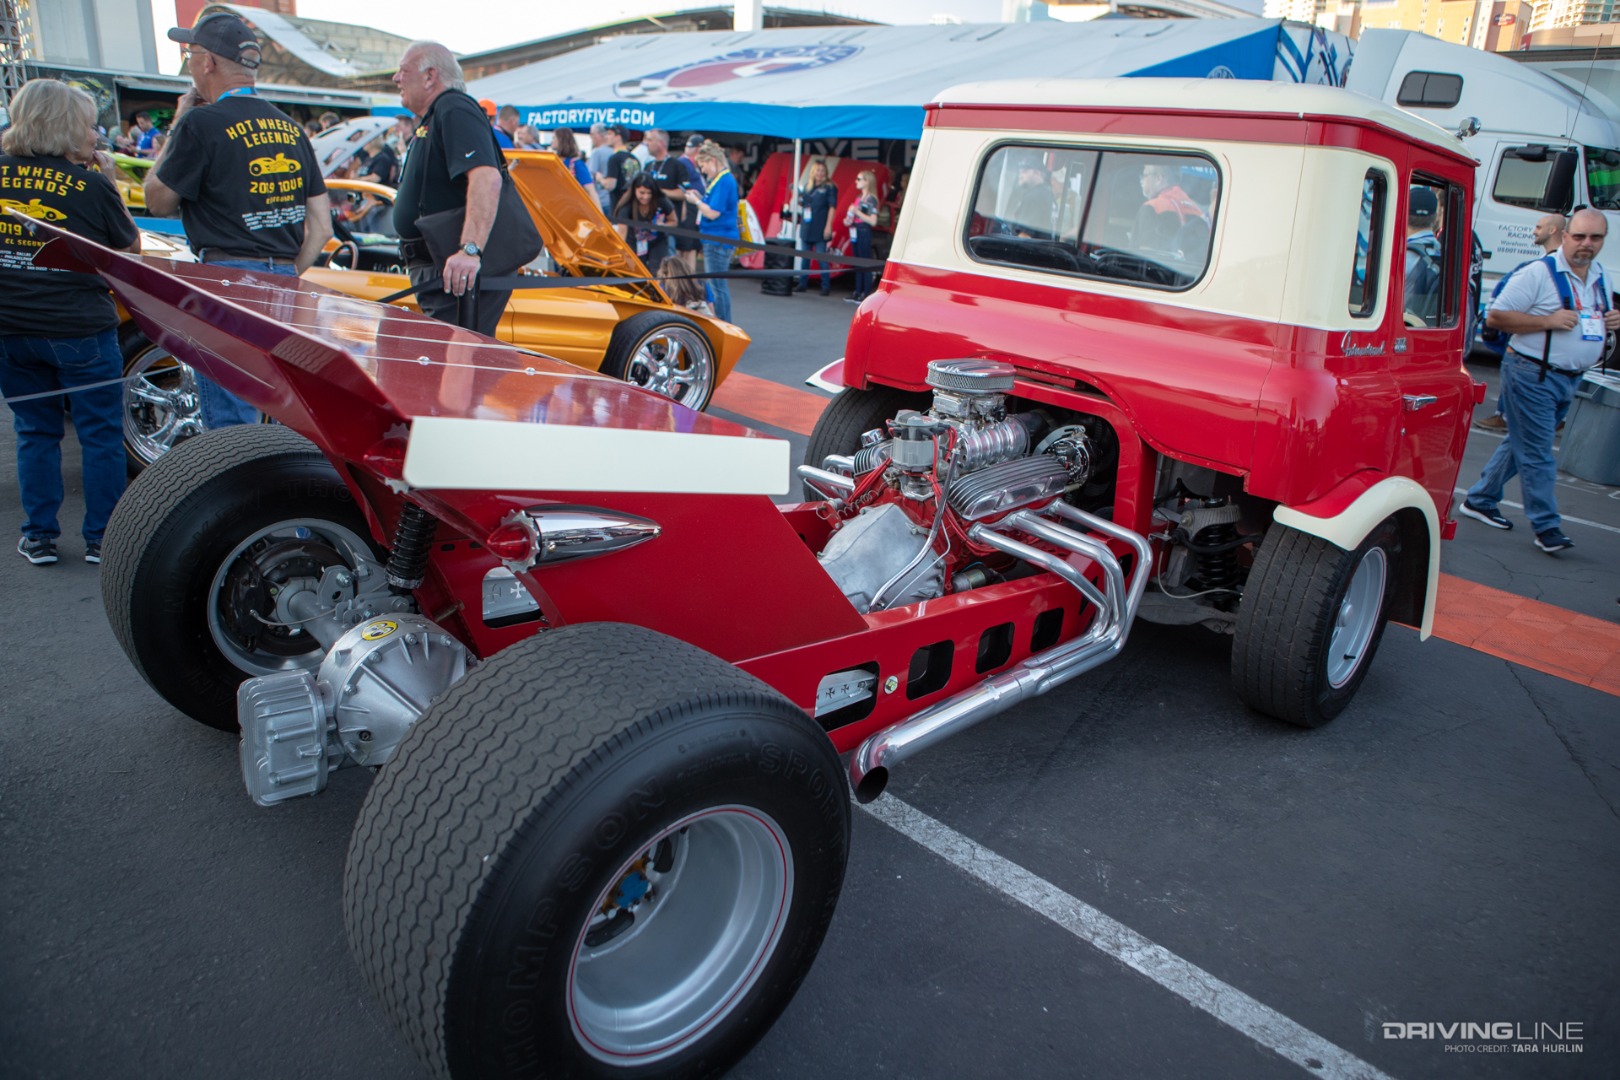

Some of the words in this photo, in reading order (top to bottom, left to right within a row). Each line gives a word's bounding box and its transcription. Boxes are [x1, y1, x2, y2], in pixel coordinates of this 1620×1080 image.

[527, 107, 656, 127] FACTORYFIVE.COM
[225, 119, 254, 140] HOT
[256, 117, 301, 138] WHEELS
[242, 131, 297, 149] LEGENDS
[0, 177, 69, 197] EGENDS
[17, 165, 87, 192] WHEELS
[0, 221, 23, 236] 019
[1498, 224, 1534, 233] FACTORY
[501, 771, 667, 1078] HOMPSON
